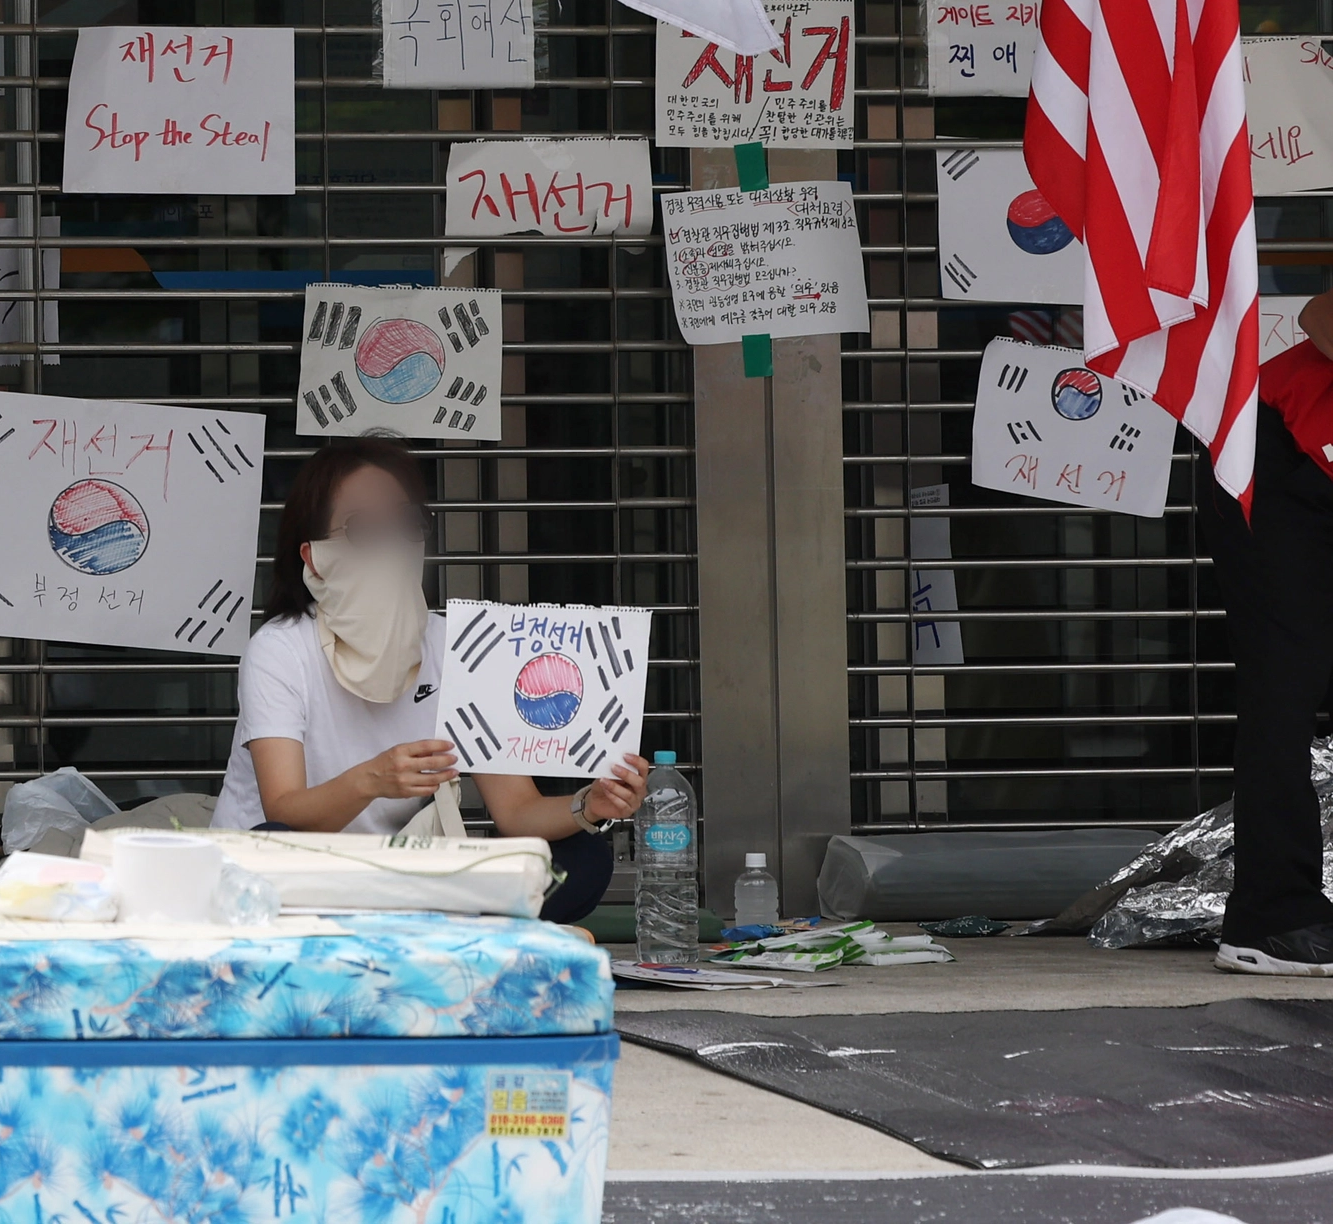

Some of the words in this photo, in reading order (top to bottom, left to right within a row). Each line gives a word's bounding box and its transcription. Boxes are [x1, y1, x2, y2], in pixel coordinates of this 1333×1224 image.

[937, 4, 994, 27] 게이트
[119, 32, 233, 84] 재선거
[85, 104, 149, 162] Stop
[156, 119, 192, 146] the
[200, 114, 270, 162] Steal
[459, 169, 631, 232] 재선거
[29, 418, 174, 504] 재선거
[1005, 453, 1126, 501] 재선거
[33, 574, 145, 615] 부정선거
[508, 612, 584, 657] 부정선거
[507, 736, 569, 764] 재선거
[650, 830, 687, 845] 백산수
